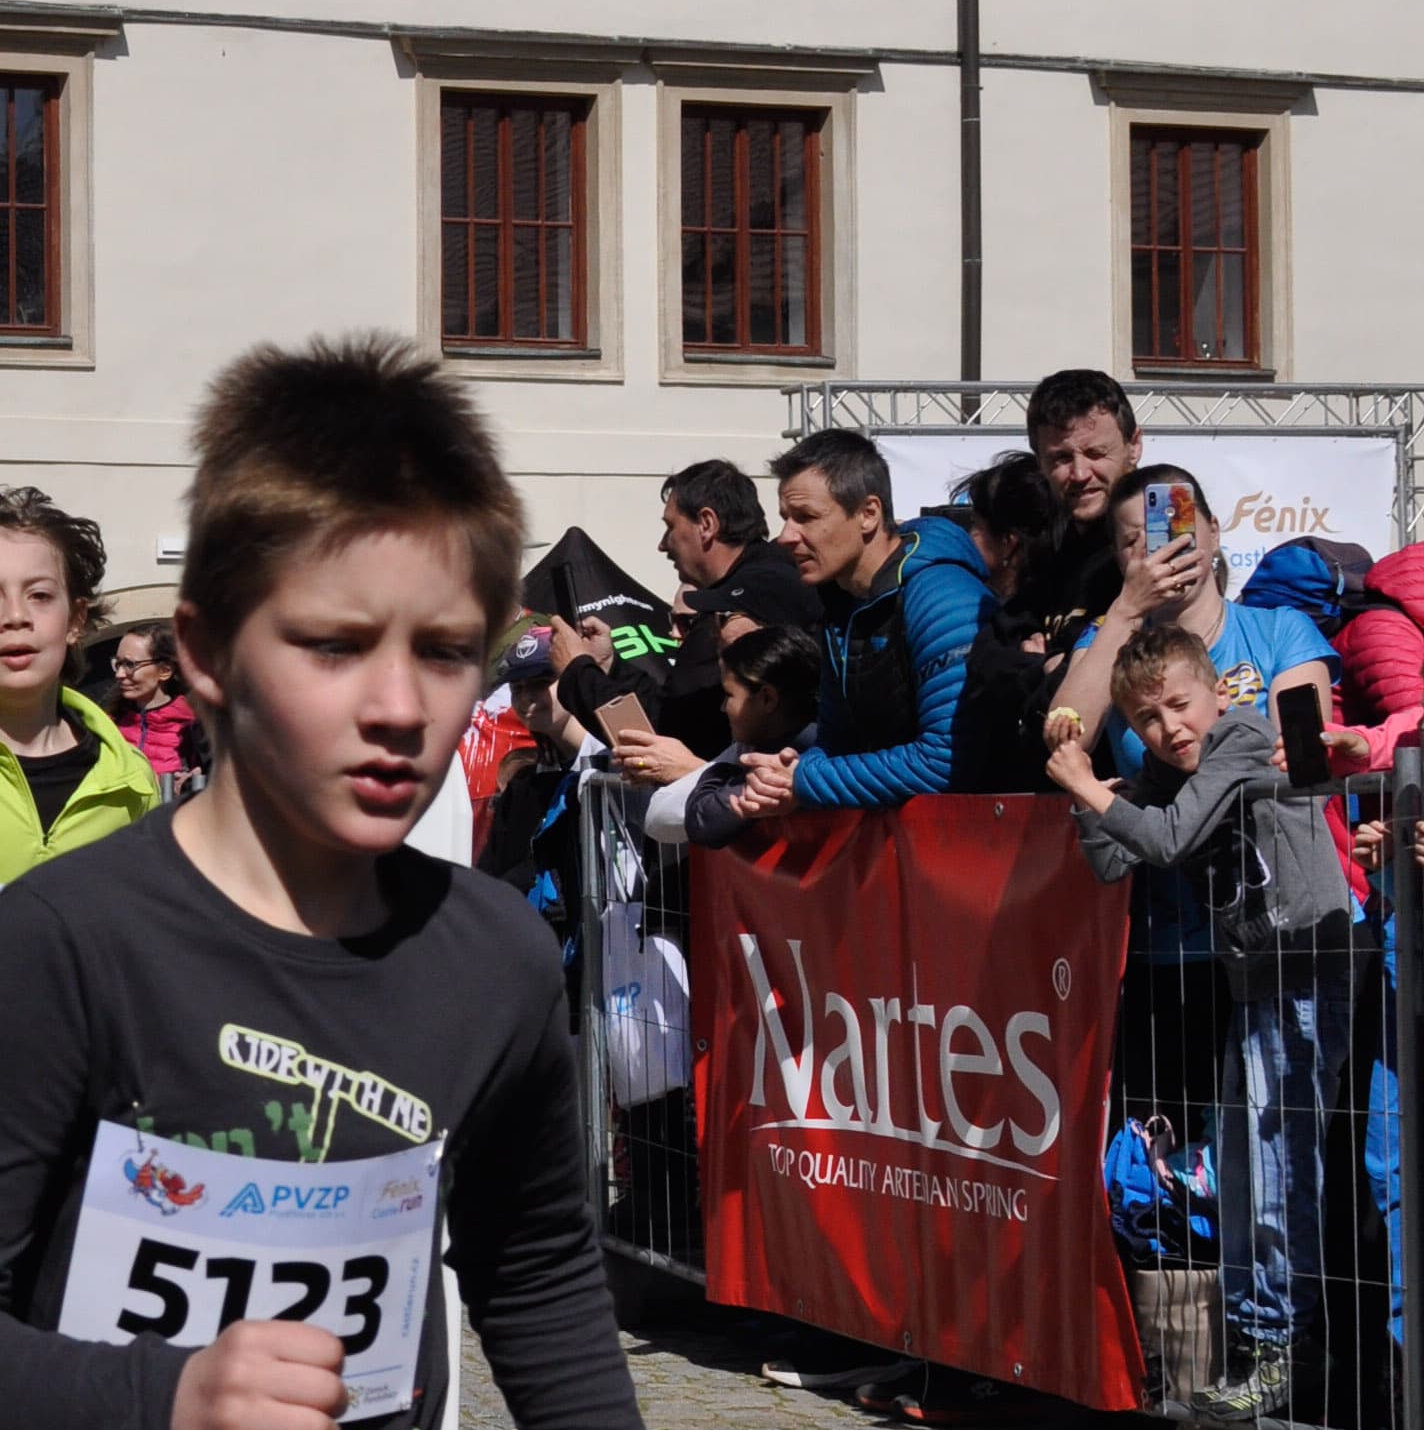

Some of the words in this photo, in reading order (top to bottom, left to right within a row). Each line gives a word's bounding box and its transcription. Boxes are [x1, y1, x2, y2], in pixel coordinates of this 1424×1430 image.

[1222, 490, 1342, 533] Fénix
[1220, 545, 1266, 568] ast
[224, 1029, 299, 1083] RIDE
[271, 1185, 351, 1211] PVZP
[767, 1144, 796, 1177] TOP
[798, 1151, 877, 1191] QUALITY
[963, 1180, 1028, 1222] SPRING
[116, 1237, 390, 1357] 5123
